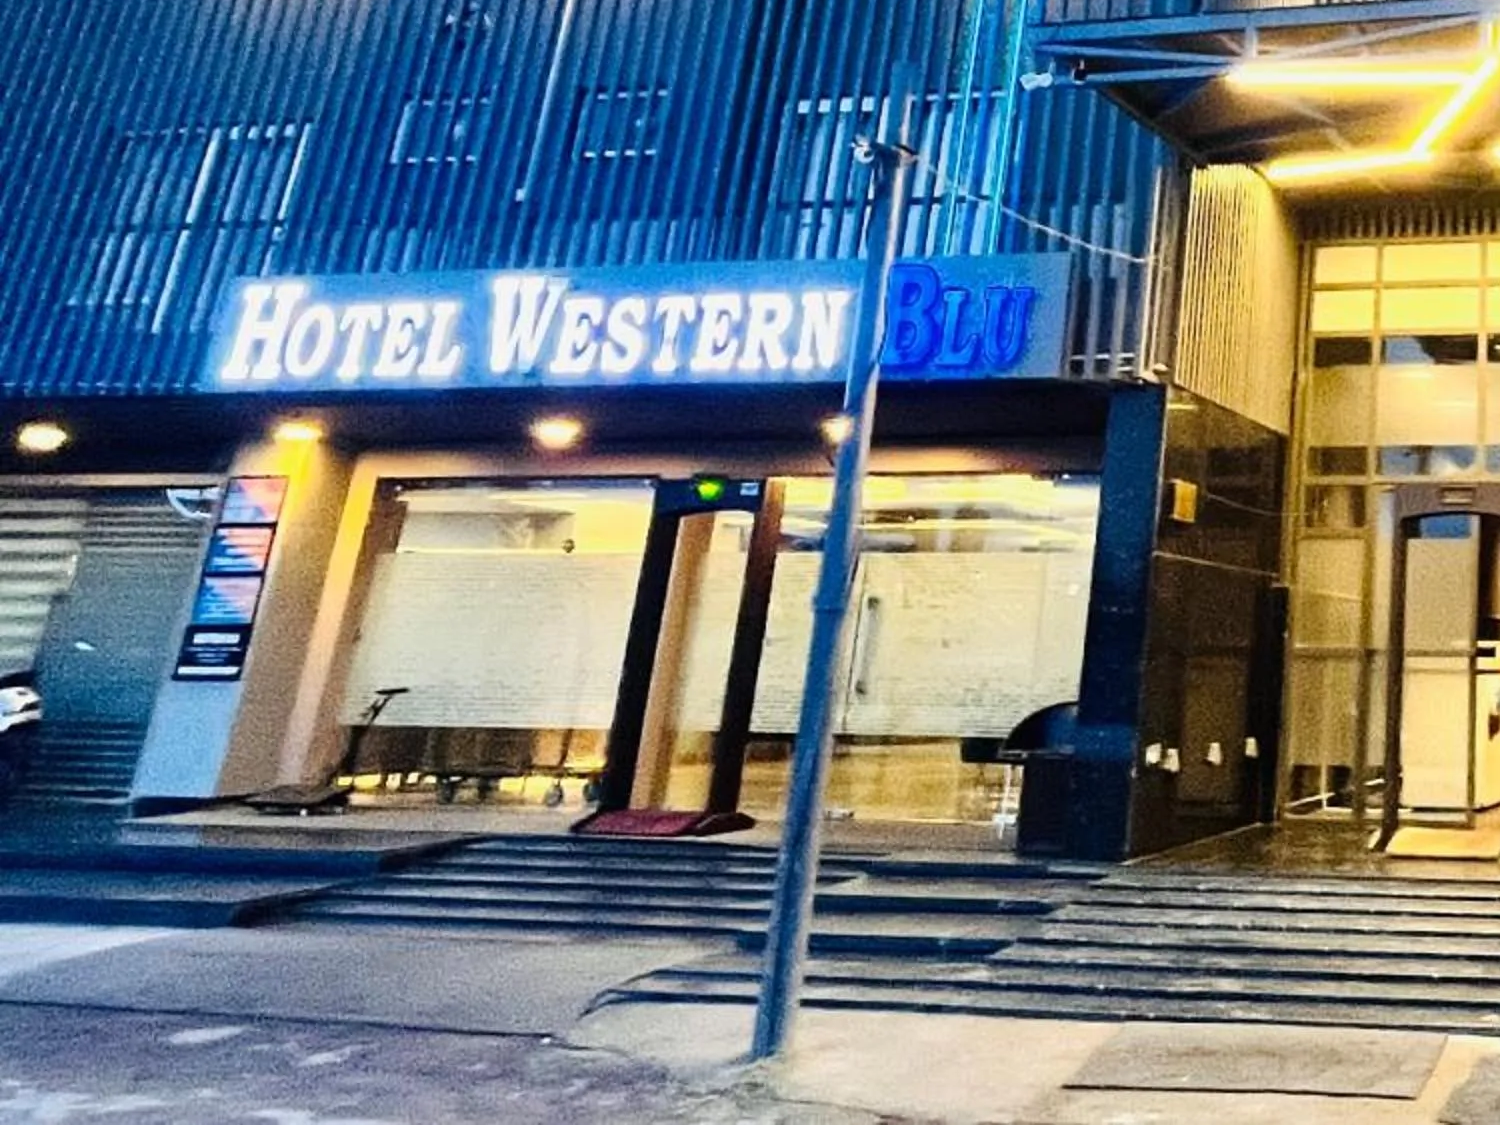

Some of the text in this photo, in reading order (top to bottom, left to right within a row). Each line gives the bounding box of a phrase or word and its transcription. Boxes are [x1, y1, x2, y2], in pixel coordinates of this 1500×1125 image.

[221, 263, 1034, 381] HOTEL WESTERN BLU
